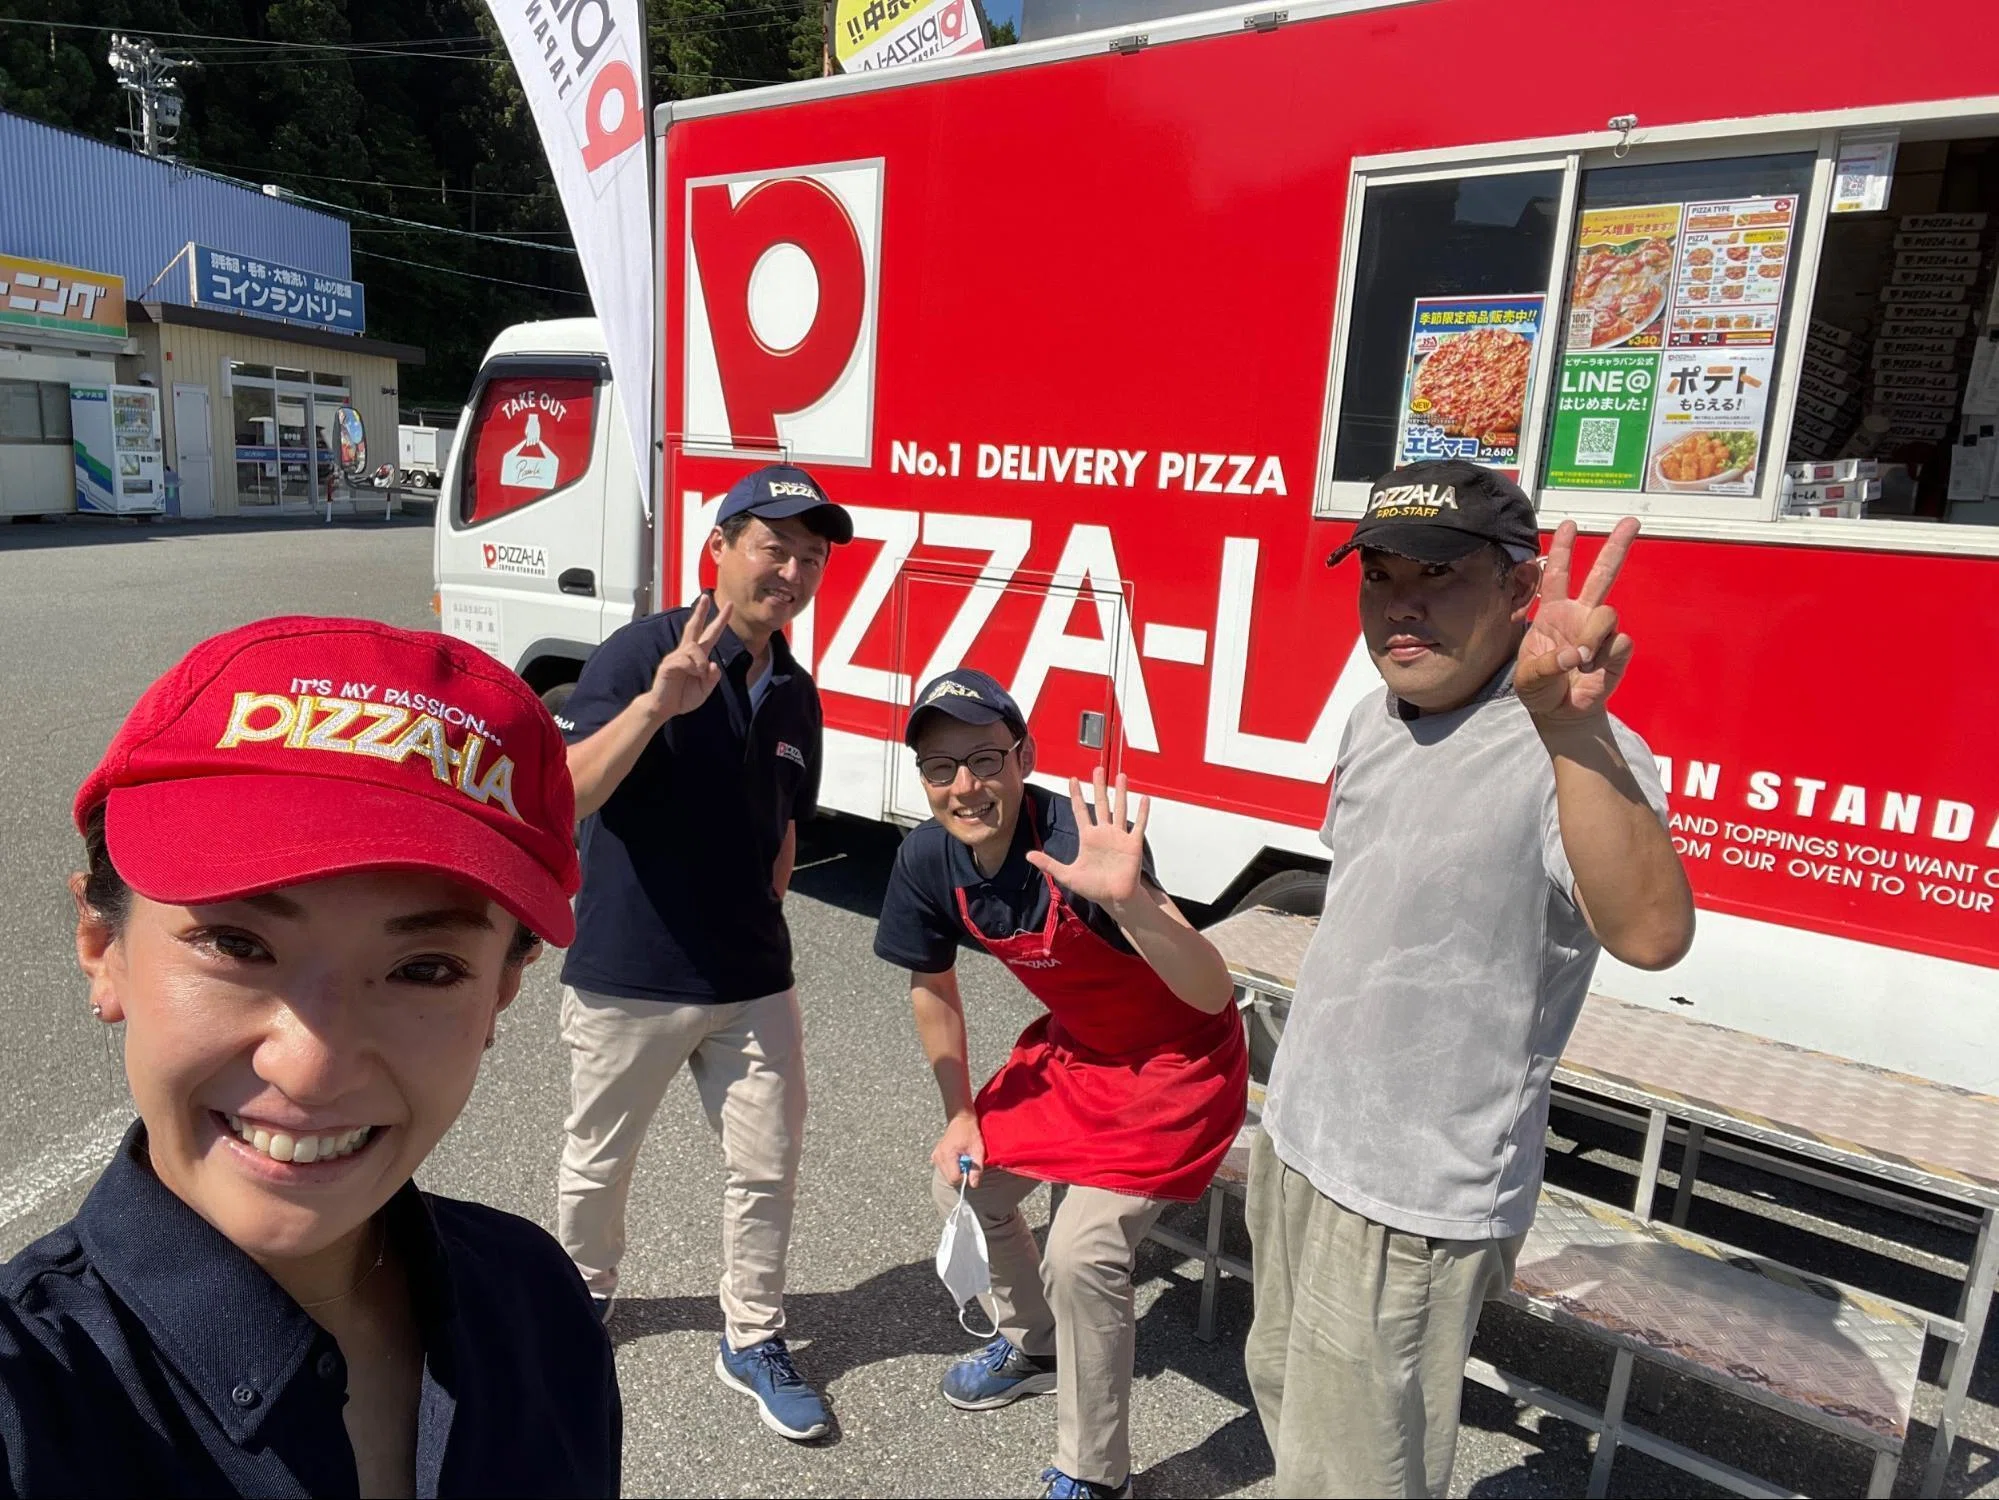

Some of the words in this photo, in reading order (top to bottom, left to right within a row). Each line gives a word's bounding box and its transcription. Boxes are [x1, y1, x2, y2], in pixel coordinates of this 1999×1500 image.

[212, 274, 352, 322] コインランドリー
[1565, 357, 1654, 367] ピザーラキャラバン公式
[1562, 369, 1652, 393] LINE@
[1666, 365, 1762, 395] ポテト
[502, 390, 536, 420] TAKE
[540, 393, 567, 422] OUT
[1412, 400, 1430, 410] NEW
[1560, 397, 1648, 411] はじめました!
[1680, 398, 1743, 411] もらえる!
[1407, 426, 1444, 437] ピザーラ
[1404, 437, 1478, 458] エビマヨ
[1480, 447, 1514, 457] ¥2,680
[891, 440, 961, 478] No.1
[978, 443, 1150, 486] DELIVERY
[1158, 451, 1288, 496] PIZZA
[1376, 506, 1440, 519] PRO-STAFF
[498, 546, 546, 568] PIZZA-LA
[683, 490, 1369, 785] ZZA-L
[290, 677, 333, 696] IT'S
[340, 681, 377, 700] MY
[1668, 813, 1719, 837] AND
[1724, 821, 1840, 859] TOPPINGS
[1843, 841, 1898, 870] YOU
[1903, 853, 1979, 885] WANT
[1669, 835, 1712, 861] OM
[1721, 846, 1777, 873] OUR
[1787, 857, 1863, 889] OVEN
[1870, 872, 1906, 896] TO
[1916, 881, 1995, 914] YOUR
